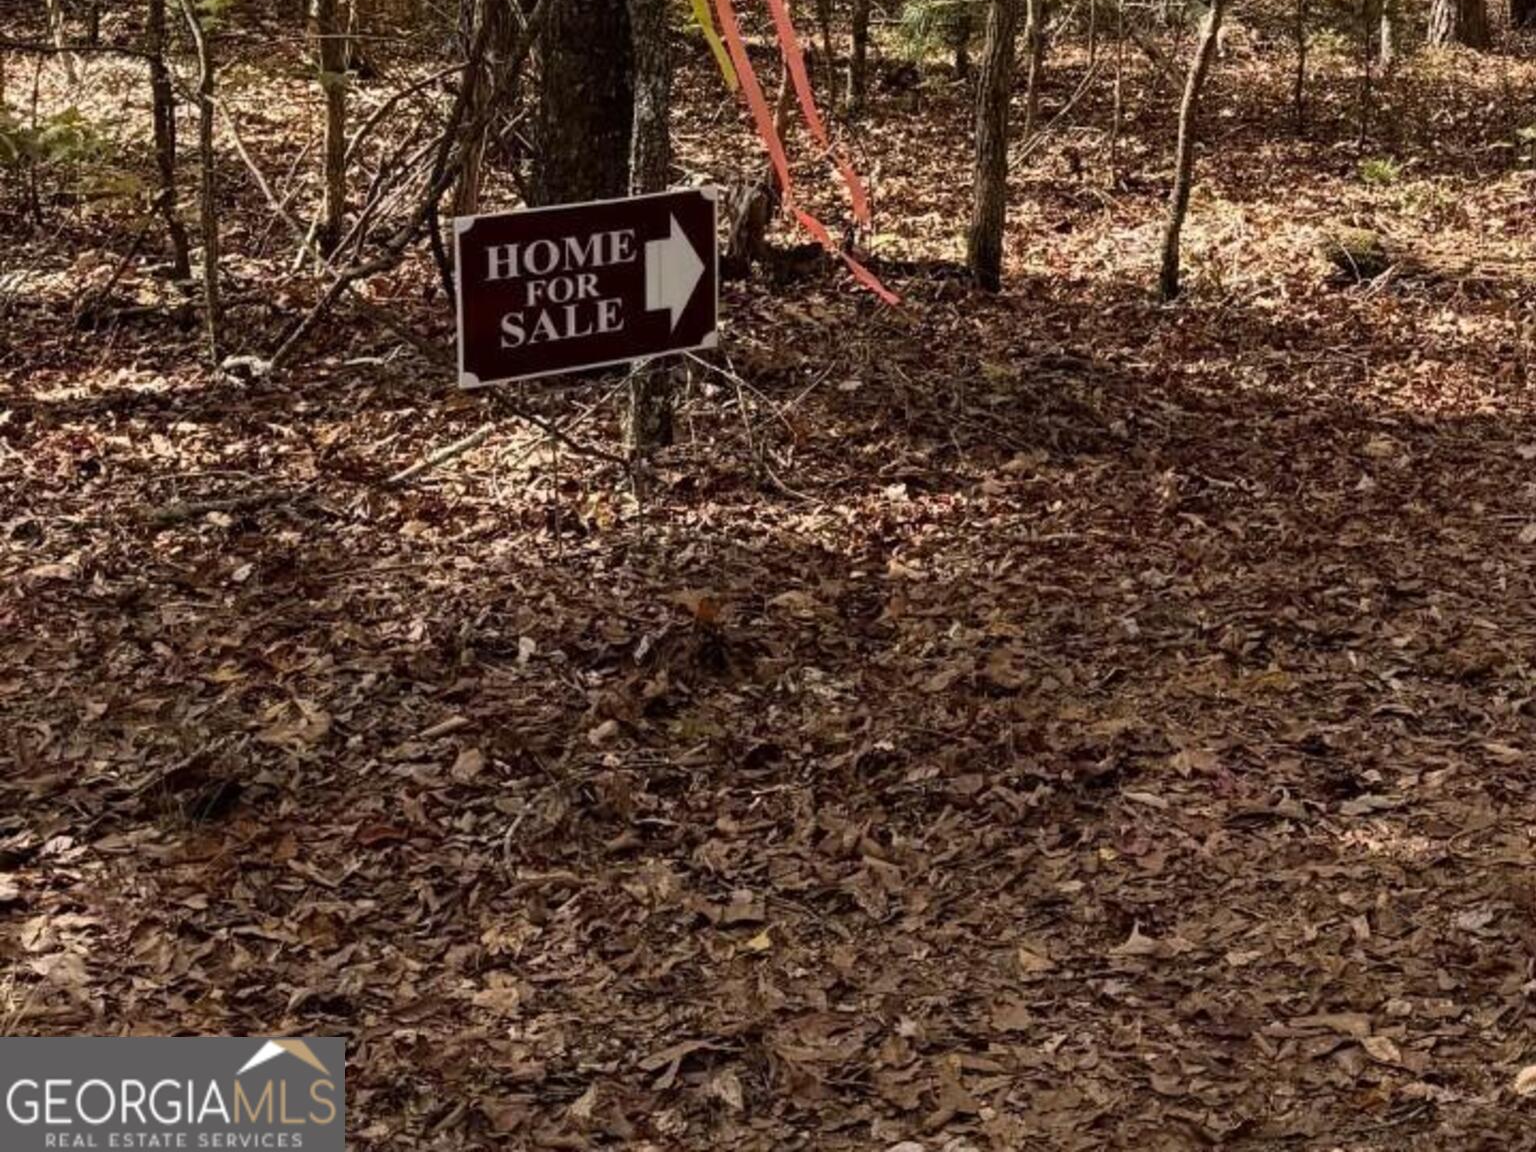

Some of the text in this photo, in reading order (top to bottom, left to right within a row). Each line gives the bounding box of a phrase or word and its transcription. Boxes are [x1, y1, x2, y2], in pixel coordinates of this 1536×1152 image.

[485, 229, 637, 281] HOME
[526, 273, 600, 307] FOR
[500, 297, 624, 349] SALE
